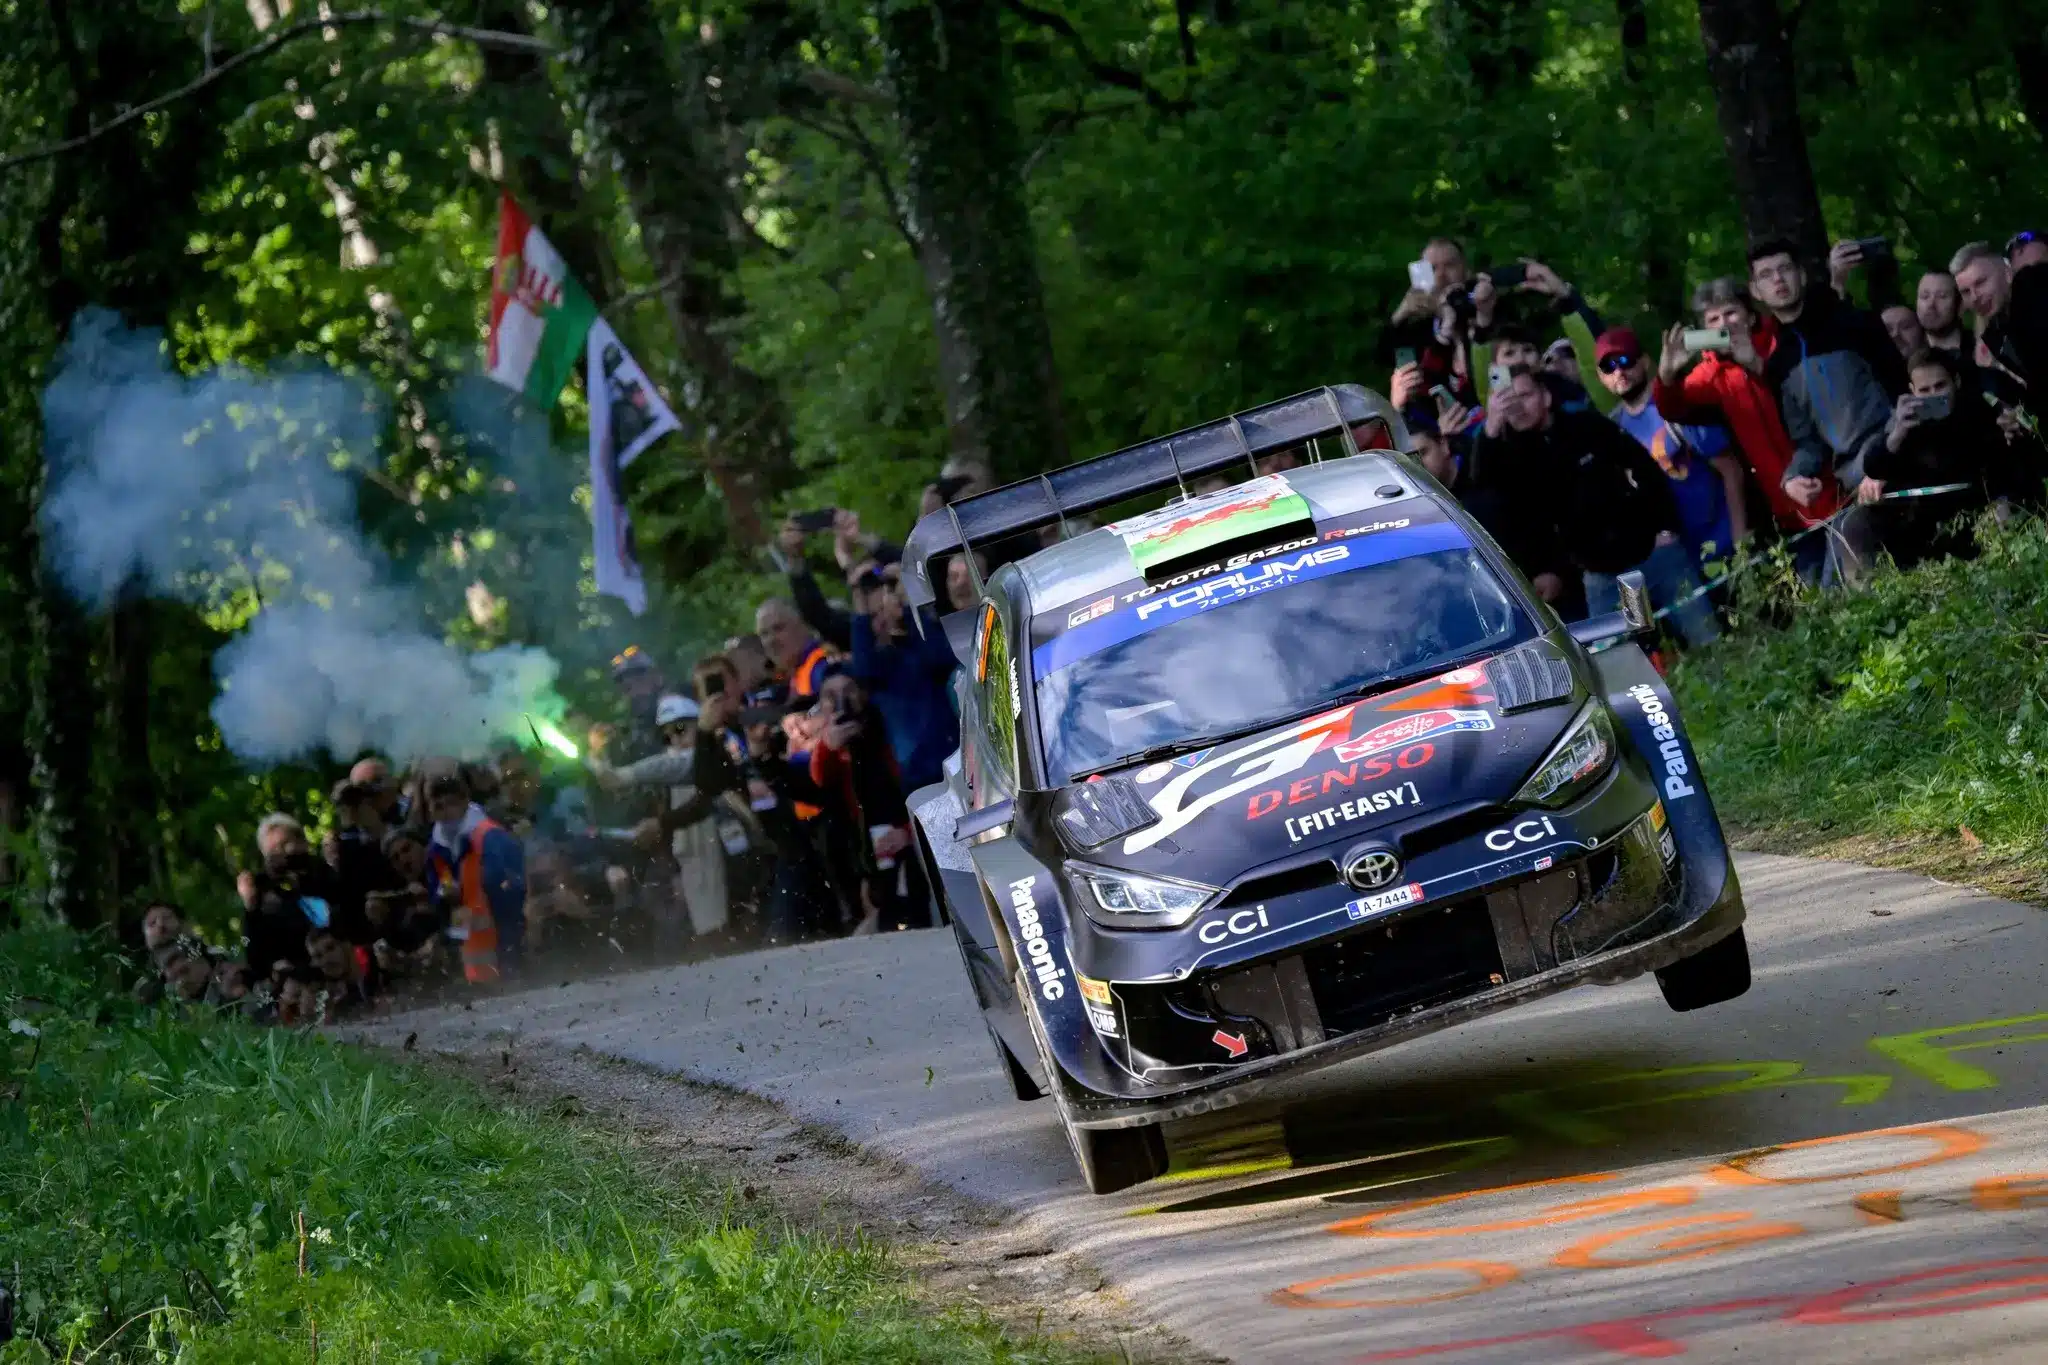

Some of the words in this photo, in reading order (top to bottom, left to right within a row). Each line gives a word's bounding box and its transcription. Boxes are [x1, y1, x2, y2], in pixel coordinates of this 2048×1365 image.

[1121, 564, 1221, 603] TOYOTA
[1225, 537, 1318, 572] GAZOO
[1324, 518, 1410, 541] Racing
[1136, 545, 1350, 621] FORUM8
[1197, 574, 1298, 609] フォーラムエイト
[1626, 683, 1695, 800] Panasonic
[1247, 743, 1435, 820] DENSO
[1009, 875, 1066, 1000] Panasonic
[1364, 891, 1407, 912] A-7444
[1093, 1011, 1117, 1033] OMP
